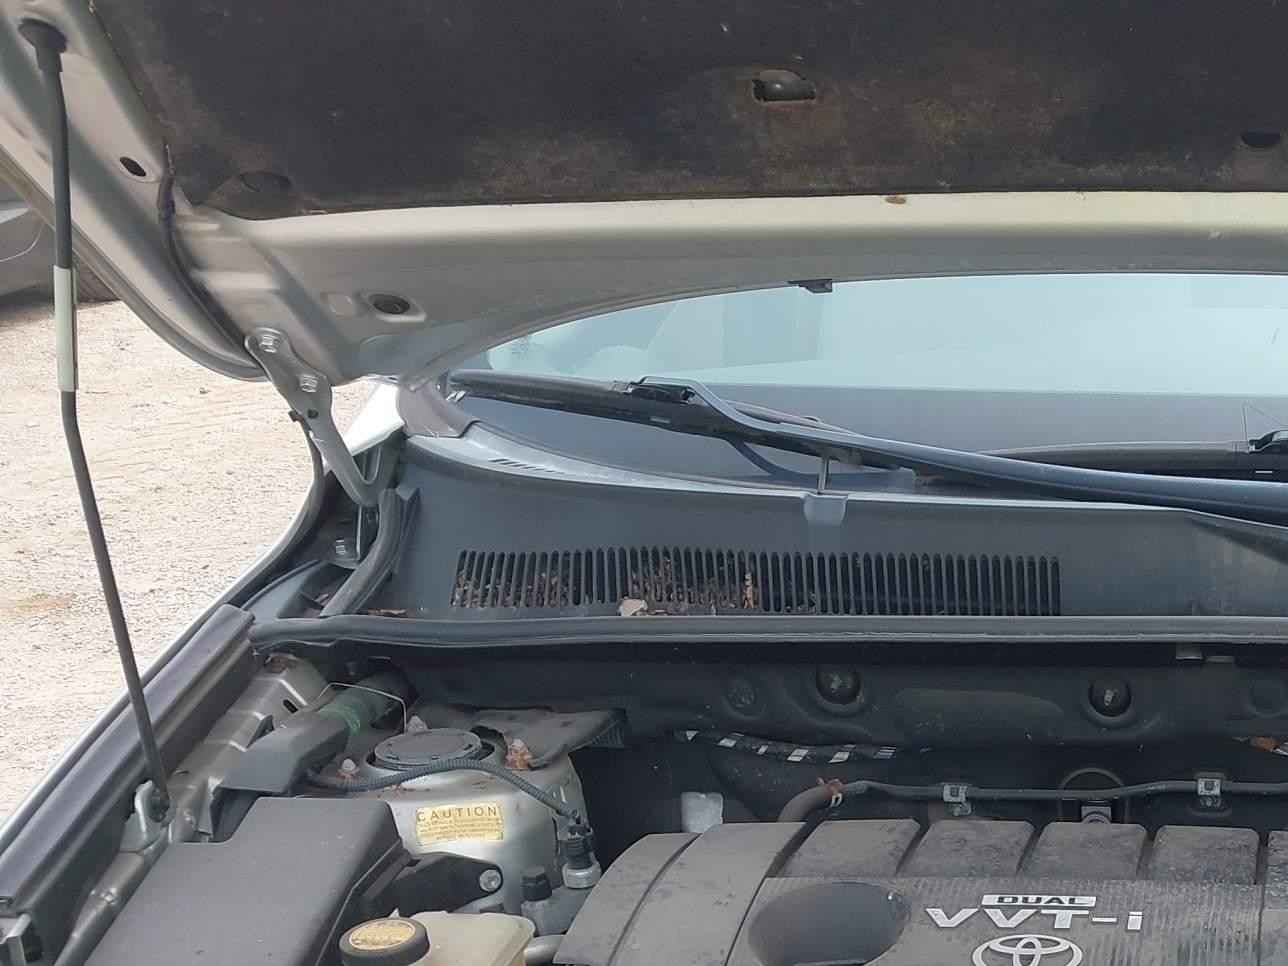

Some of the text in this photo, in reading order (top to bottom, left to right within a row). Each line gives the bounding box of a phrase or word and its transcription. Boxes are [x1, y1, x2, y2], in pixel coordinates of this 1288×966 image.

[417, 806, 498, 822] CAUTION
[996, 896, 1090, 905] DUAL
[925, 908, 1143, 930] VVT-i
